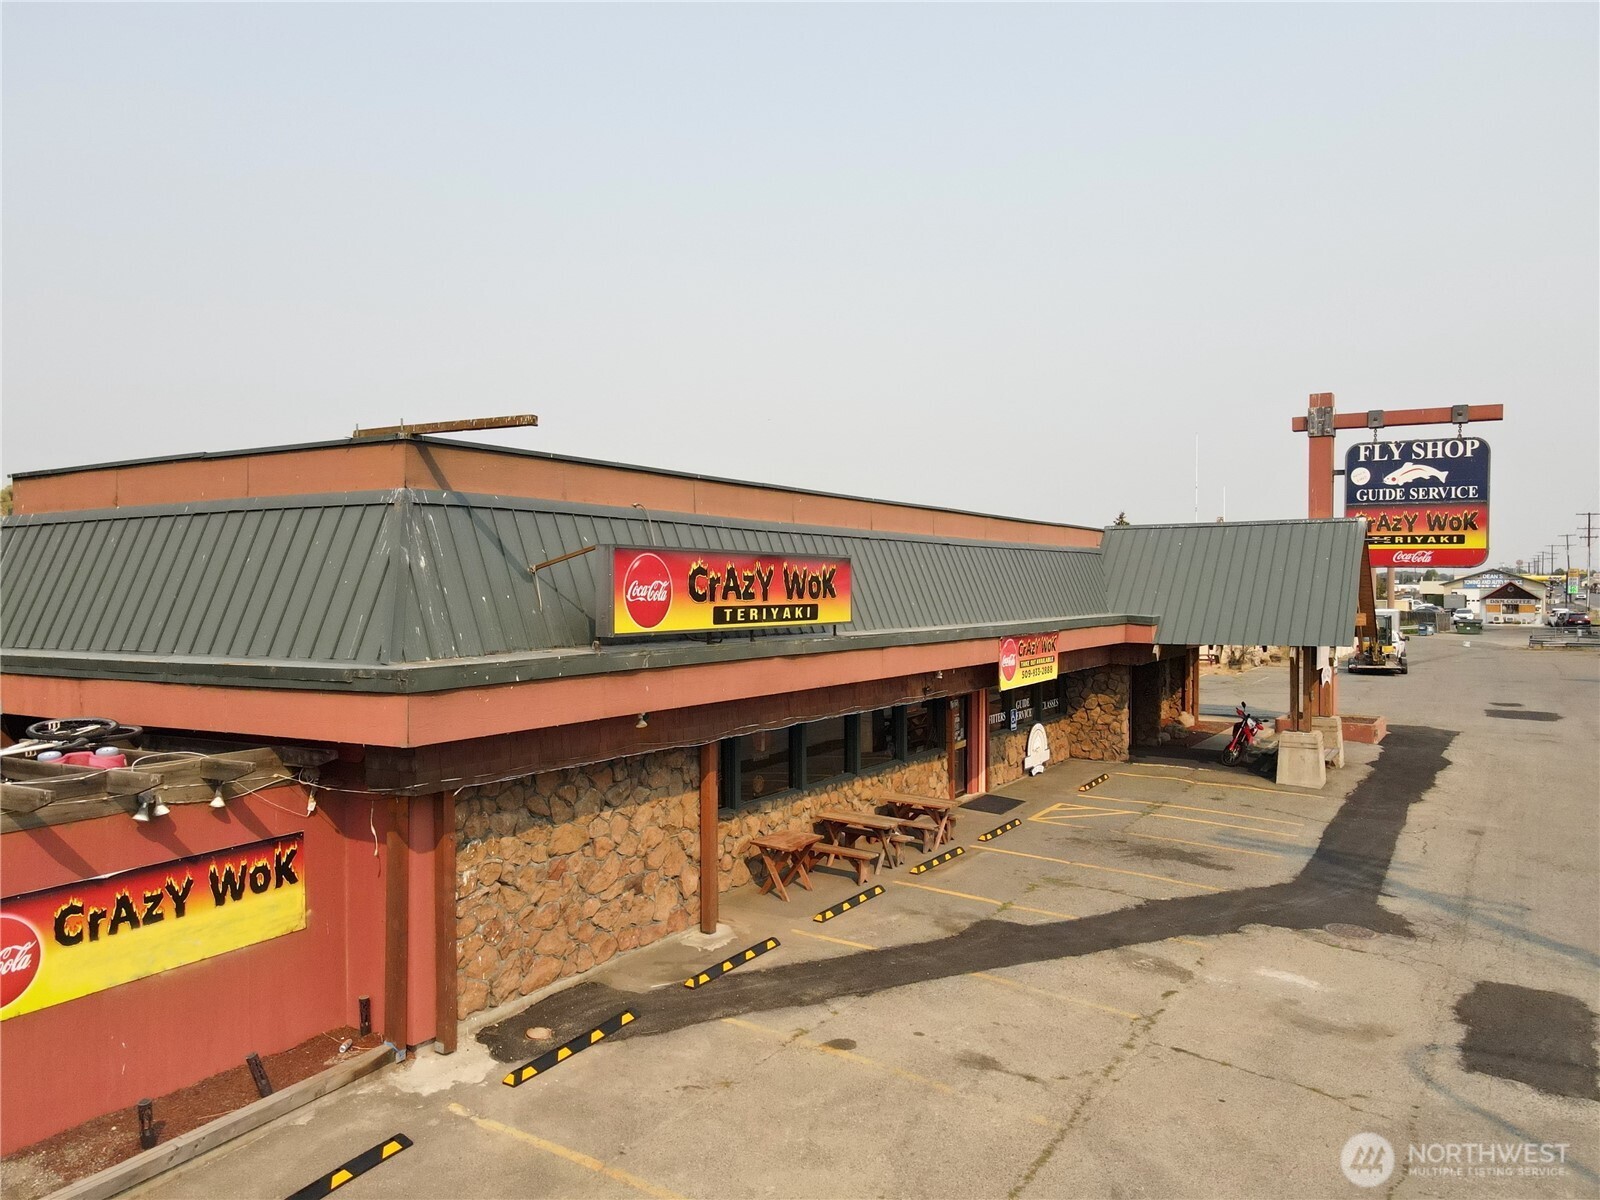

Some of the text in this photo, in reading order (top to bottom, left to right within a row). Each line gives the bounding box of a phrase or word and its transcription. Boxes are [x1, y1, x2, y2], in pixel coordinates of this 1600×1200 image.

[1358, 439, 1480, 462] FLY SHOP
[1356, 485, 1479, 502] GUIDE SERVICE
[1356, 512, 1418, 532] rAzY
[1392, 550, 1434, 563] Coca-Cola
[626, 580, 670, 602] Coca-Cola
[724, 606, 812, 622] TERIYAKI
[1016, 709, 1032, 720] ERVICE
